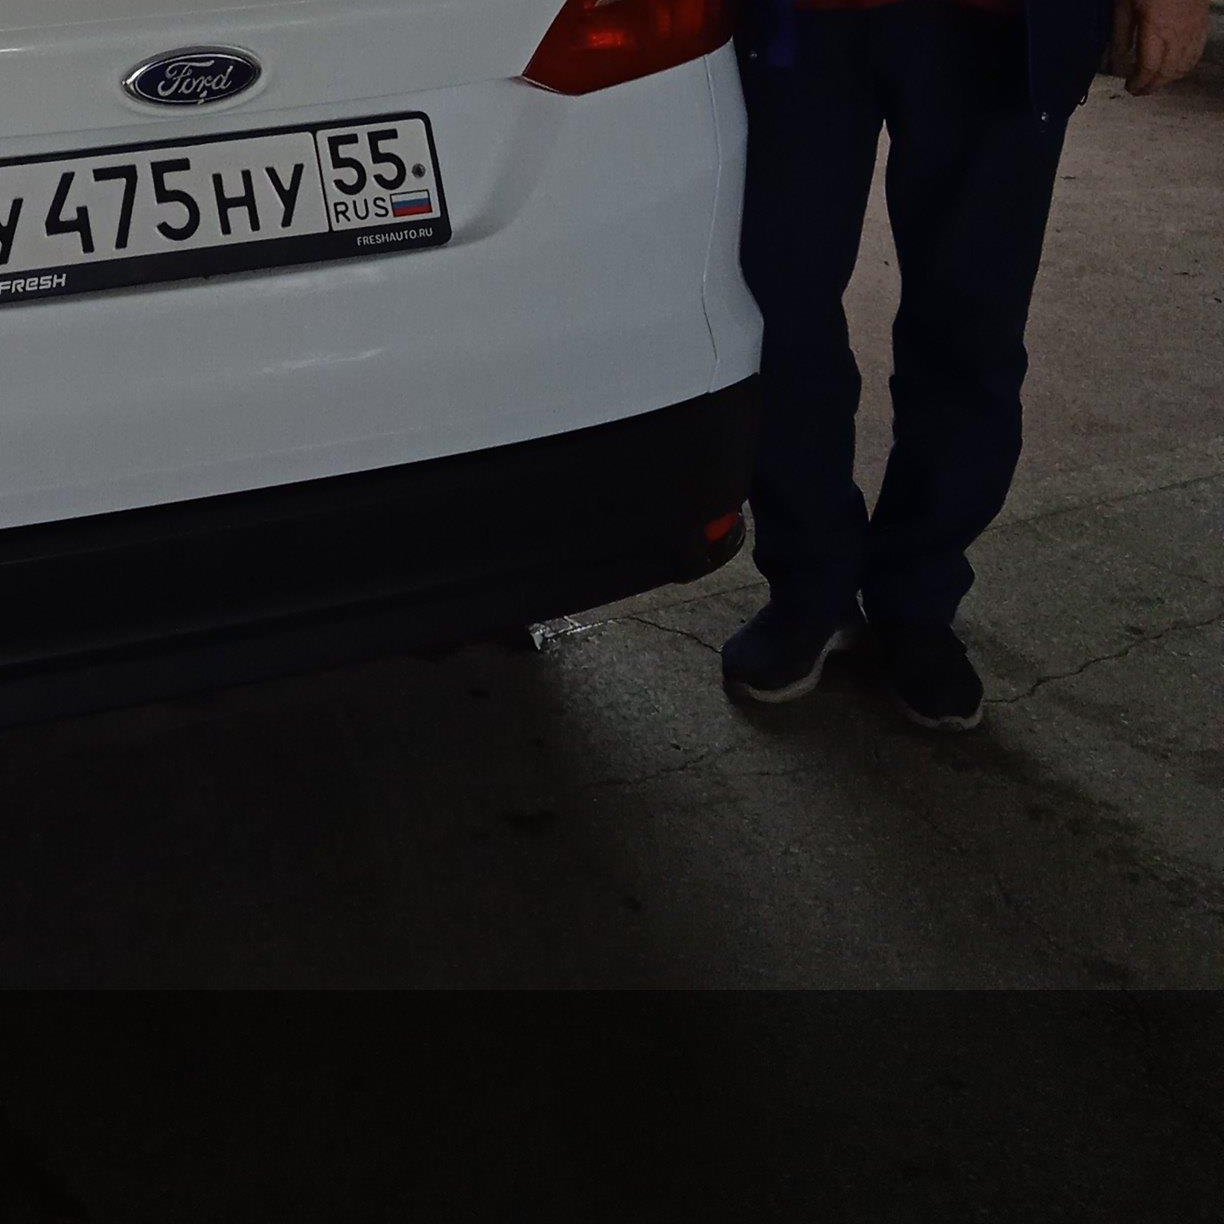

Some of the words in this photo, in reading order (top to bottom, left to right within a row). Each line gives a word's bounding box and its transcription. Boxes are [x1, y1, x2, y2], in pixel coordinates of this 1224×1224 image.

[157, 59, 233, 96] Ford
[327, 128, 407, 196] 55
[333, 196, 389, 224] RUS
[356, 227, 433, 246] FRESHAUTO.RU
